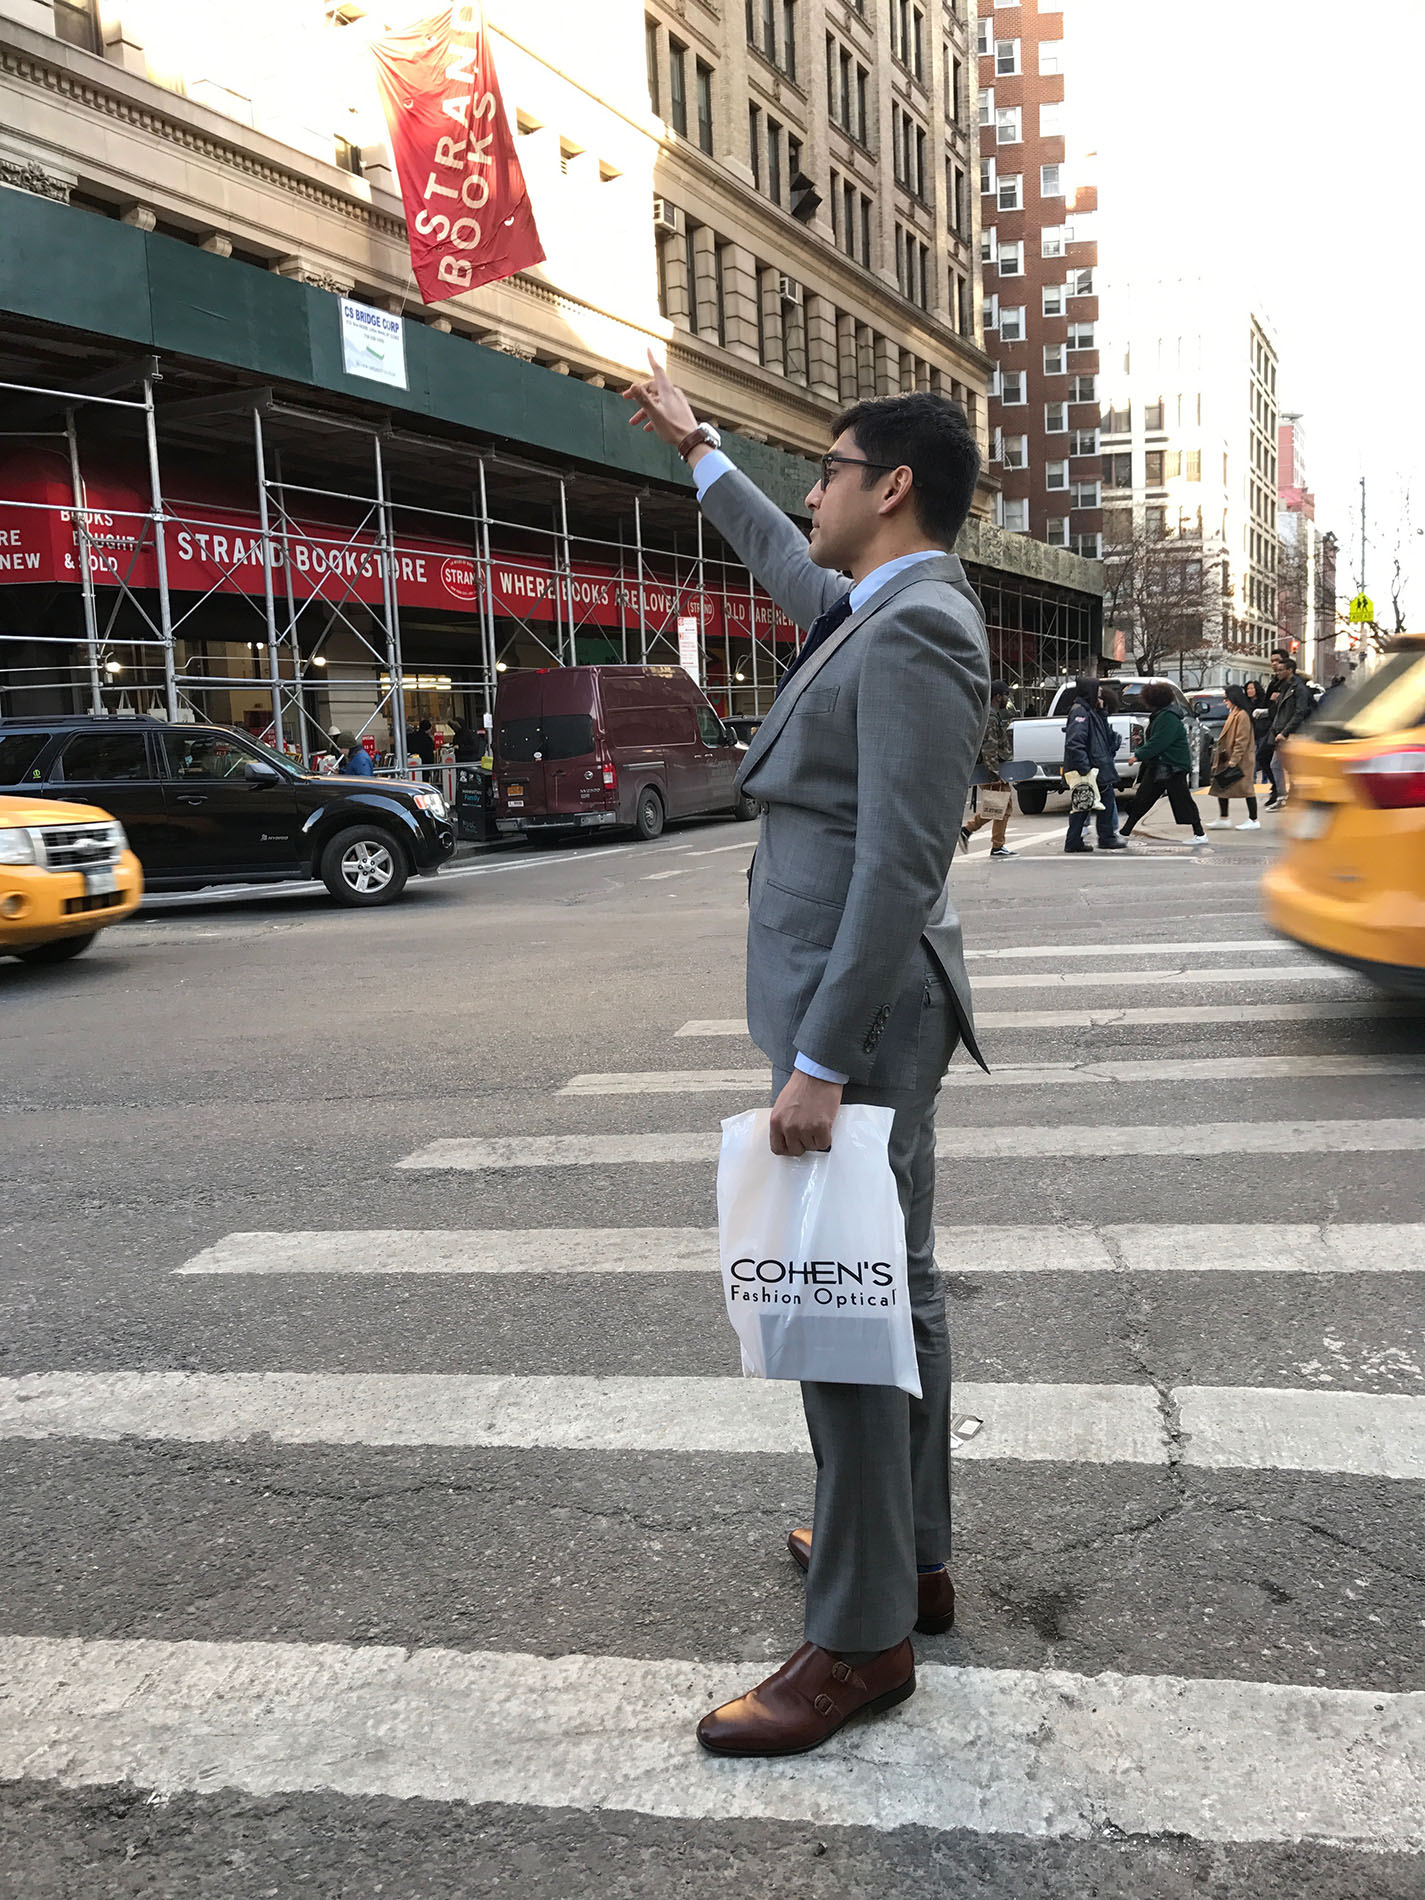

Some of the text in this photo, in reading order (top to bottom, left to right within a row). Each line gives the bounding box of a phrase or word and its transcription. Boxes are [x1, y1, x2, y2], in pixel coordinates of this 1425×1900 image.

[438, 91, 497, 287] BOOKS
[344, 306, 355, 319] CS
[355, 309, 382, 328] BRIDGE
[382, 318, 400, 333] CORP
[177, 531, 427, 583] STRAND BOOKSTORE
[500, 571, 556, 600] WHERE
[730, 1258, 893, 1287] COHEN'S
[730, 1285, 896, 1308] Fashion Optical
